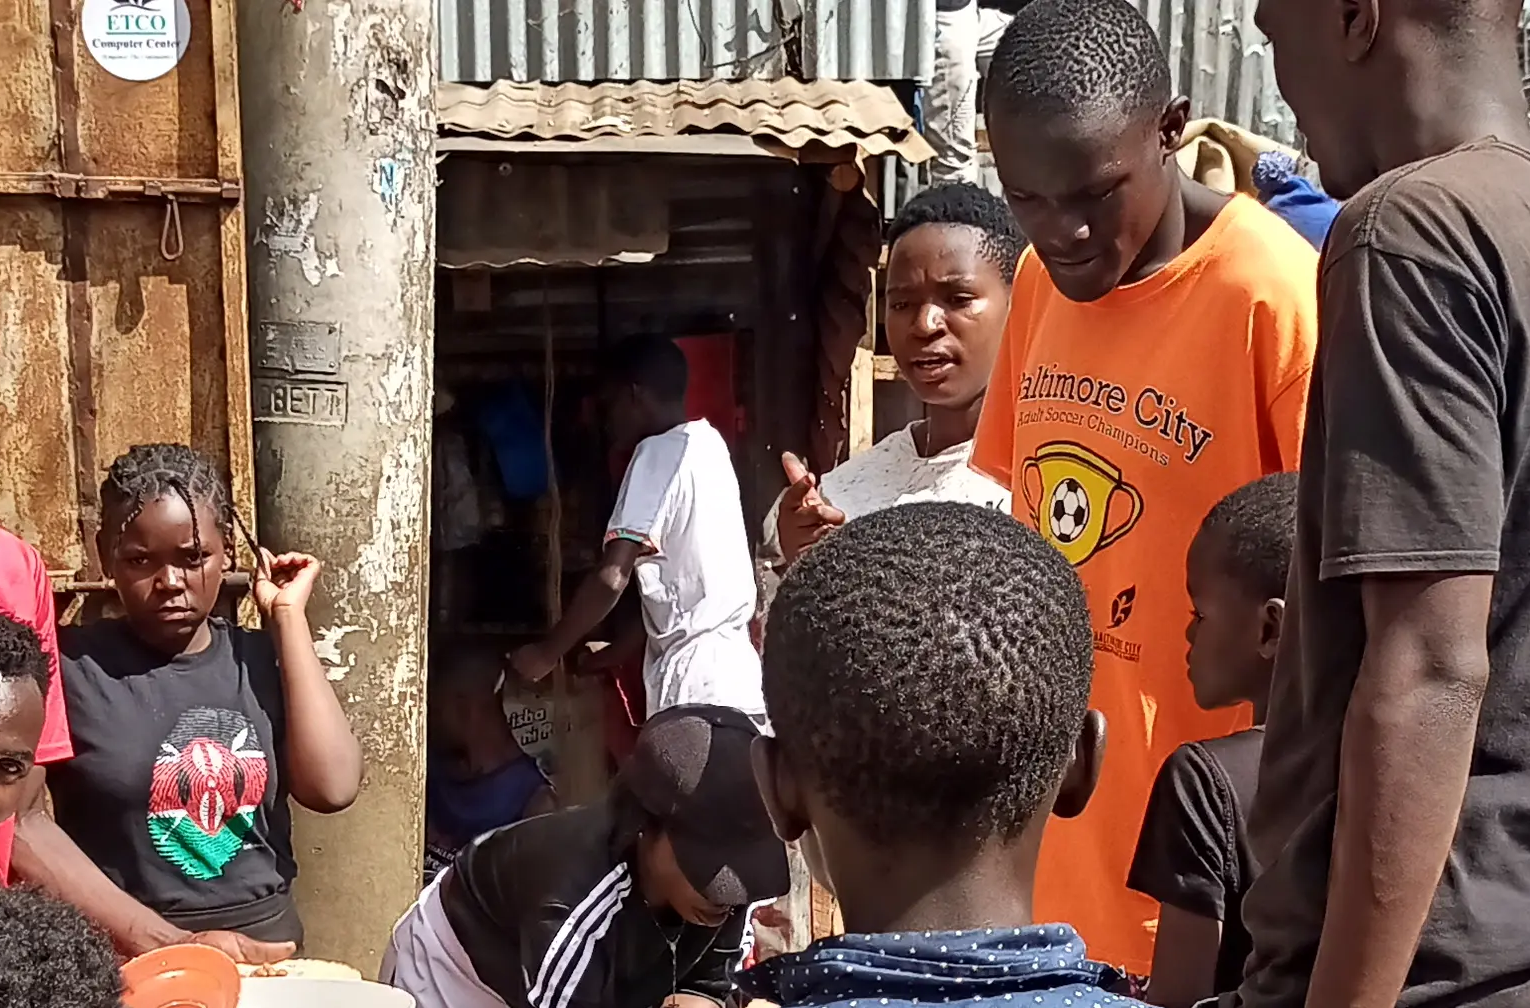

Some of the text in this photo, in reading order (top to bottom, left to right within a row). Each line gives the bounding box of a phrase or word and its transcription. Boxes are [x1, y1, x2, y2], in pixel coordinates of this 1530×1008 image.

[107, 15, 166, 30] ETCO
[92, 38, 181, 50] Computer Center
[1020, 363, 1213, 462] altimore City
[1018, 406, 1169, 467] Adult Soccer Champions
